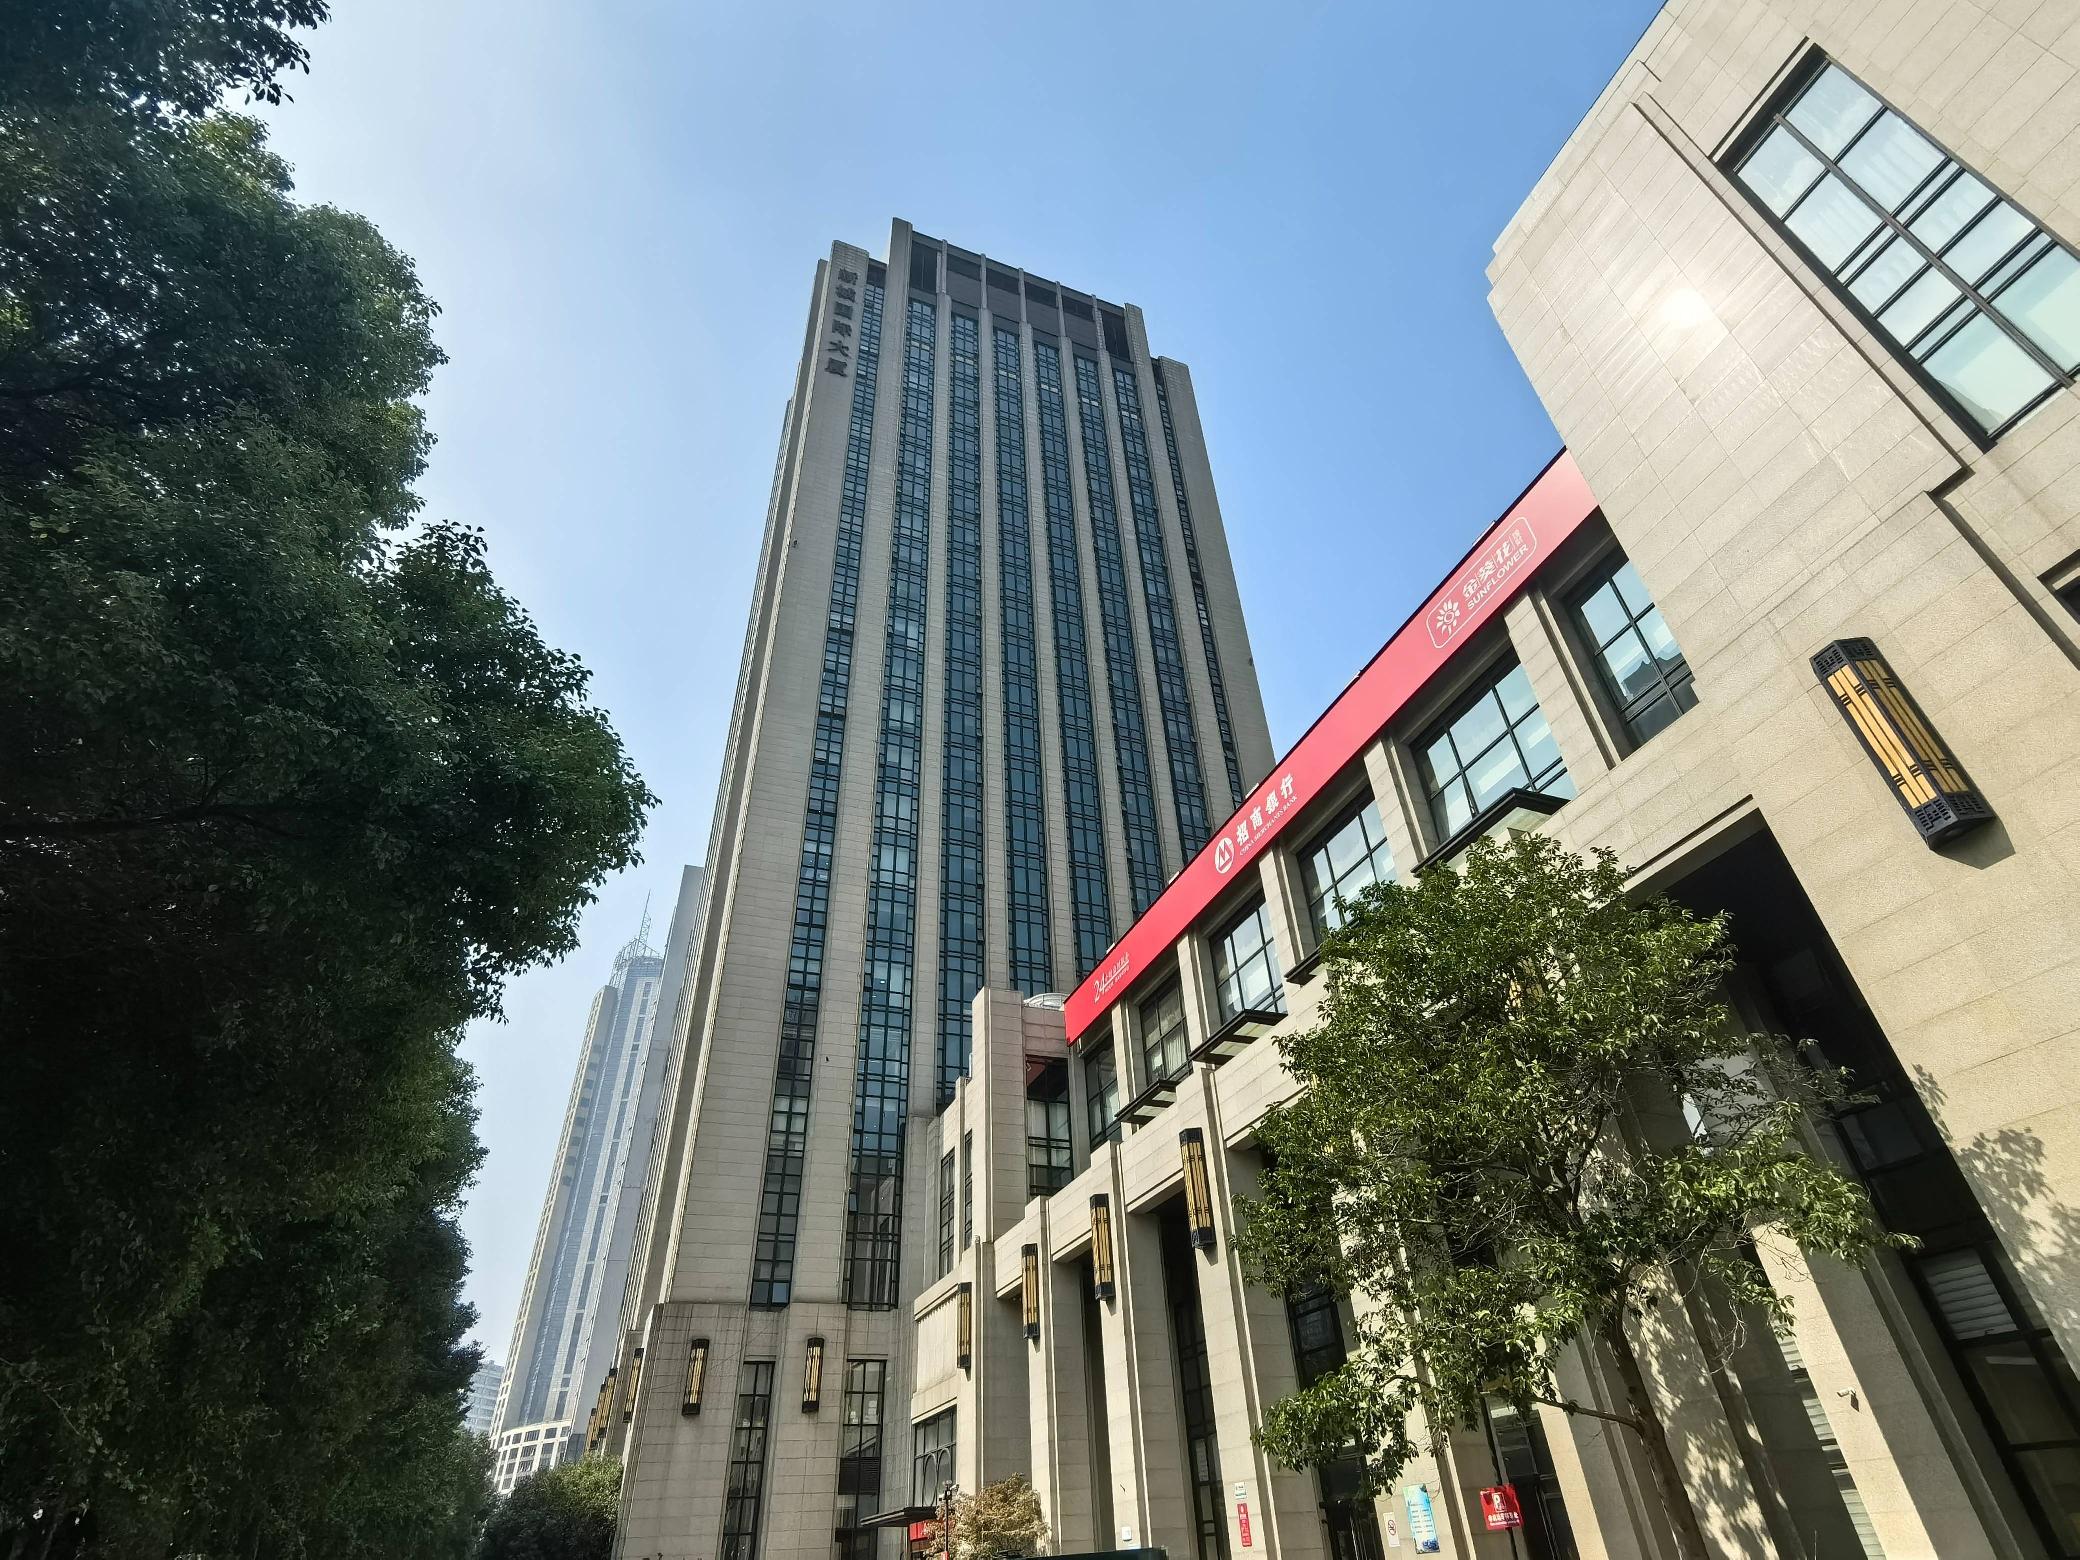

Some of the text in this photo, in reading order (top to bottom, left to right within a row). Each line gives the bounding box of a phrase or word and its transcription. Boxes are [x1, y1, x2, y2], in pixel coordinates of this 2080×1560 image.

[1463, 540, 1513, 598] 金葵花
[1467, 545, 1528, 609] SUNFLOWER
[1237, 774, 1293, 845] 招商银行
